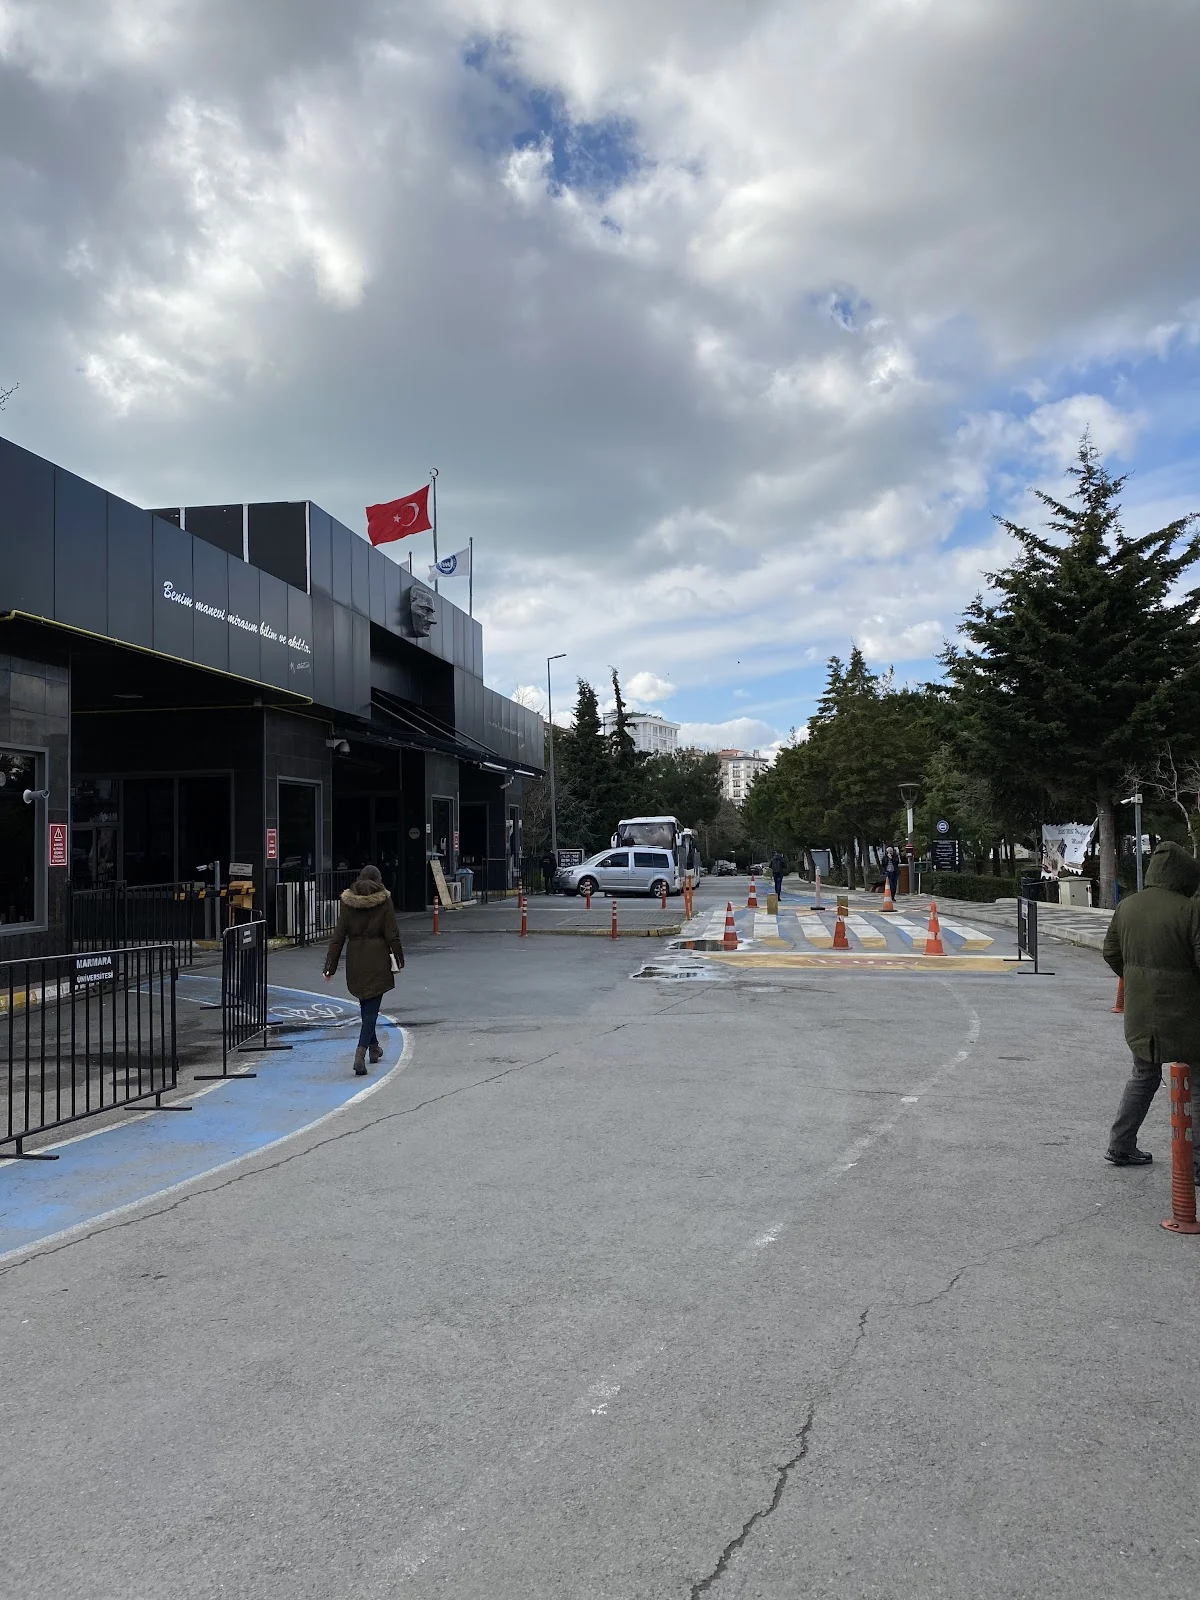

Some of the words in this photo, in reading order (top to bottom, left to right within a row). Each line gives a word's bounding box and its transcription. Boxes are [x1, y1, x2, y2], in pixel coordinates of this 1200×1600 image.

[163, 581, 193, 607] Benim
[195, 600, 226, 621] manevi
[259, 621, 278, 641] bilim
[279, 634, 287, 645] ve
[76, 956, 112, 969] MARMARA
[76, 970, 114, 983] ÜNİVERSİTESİ
